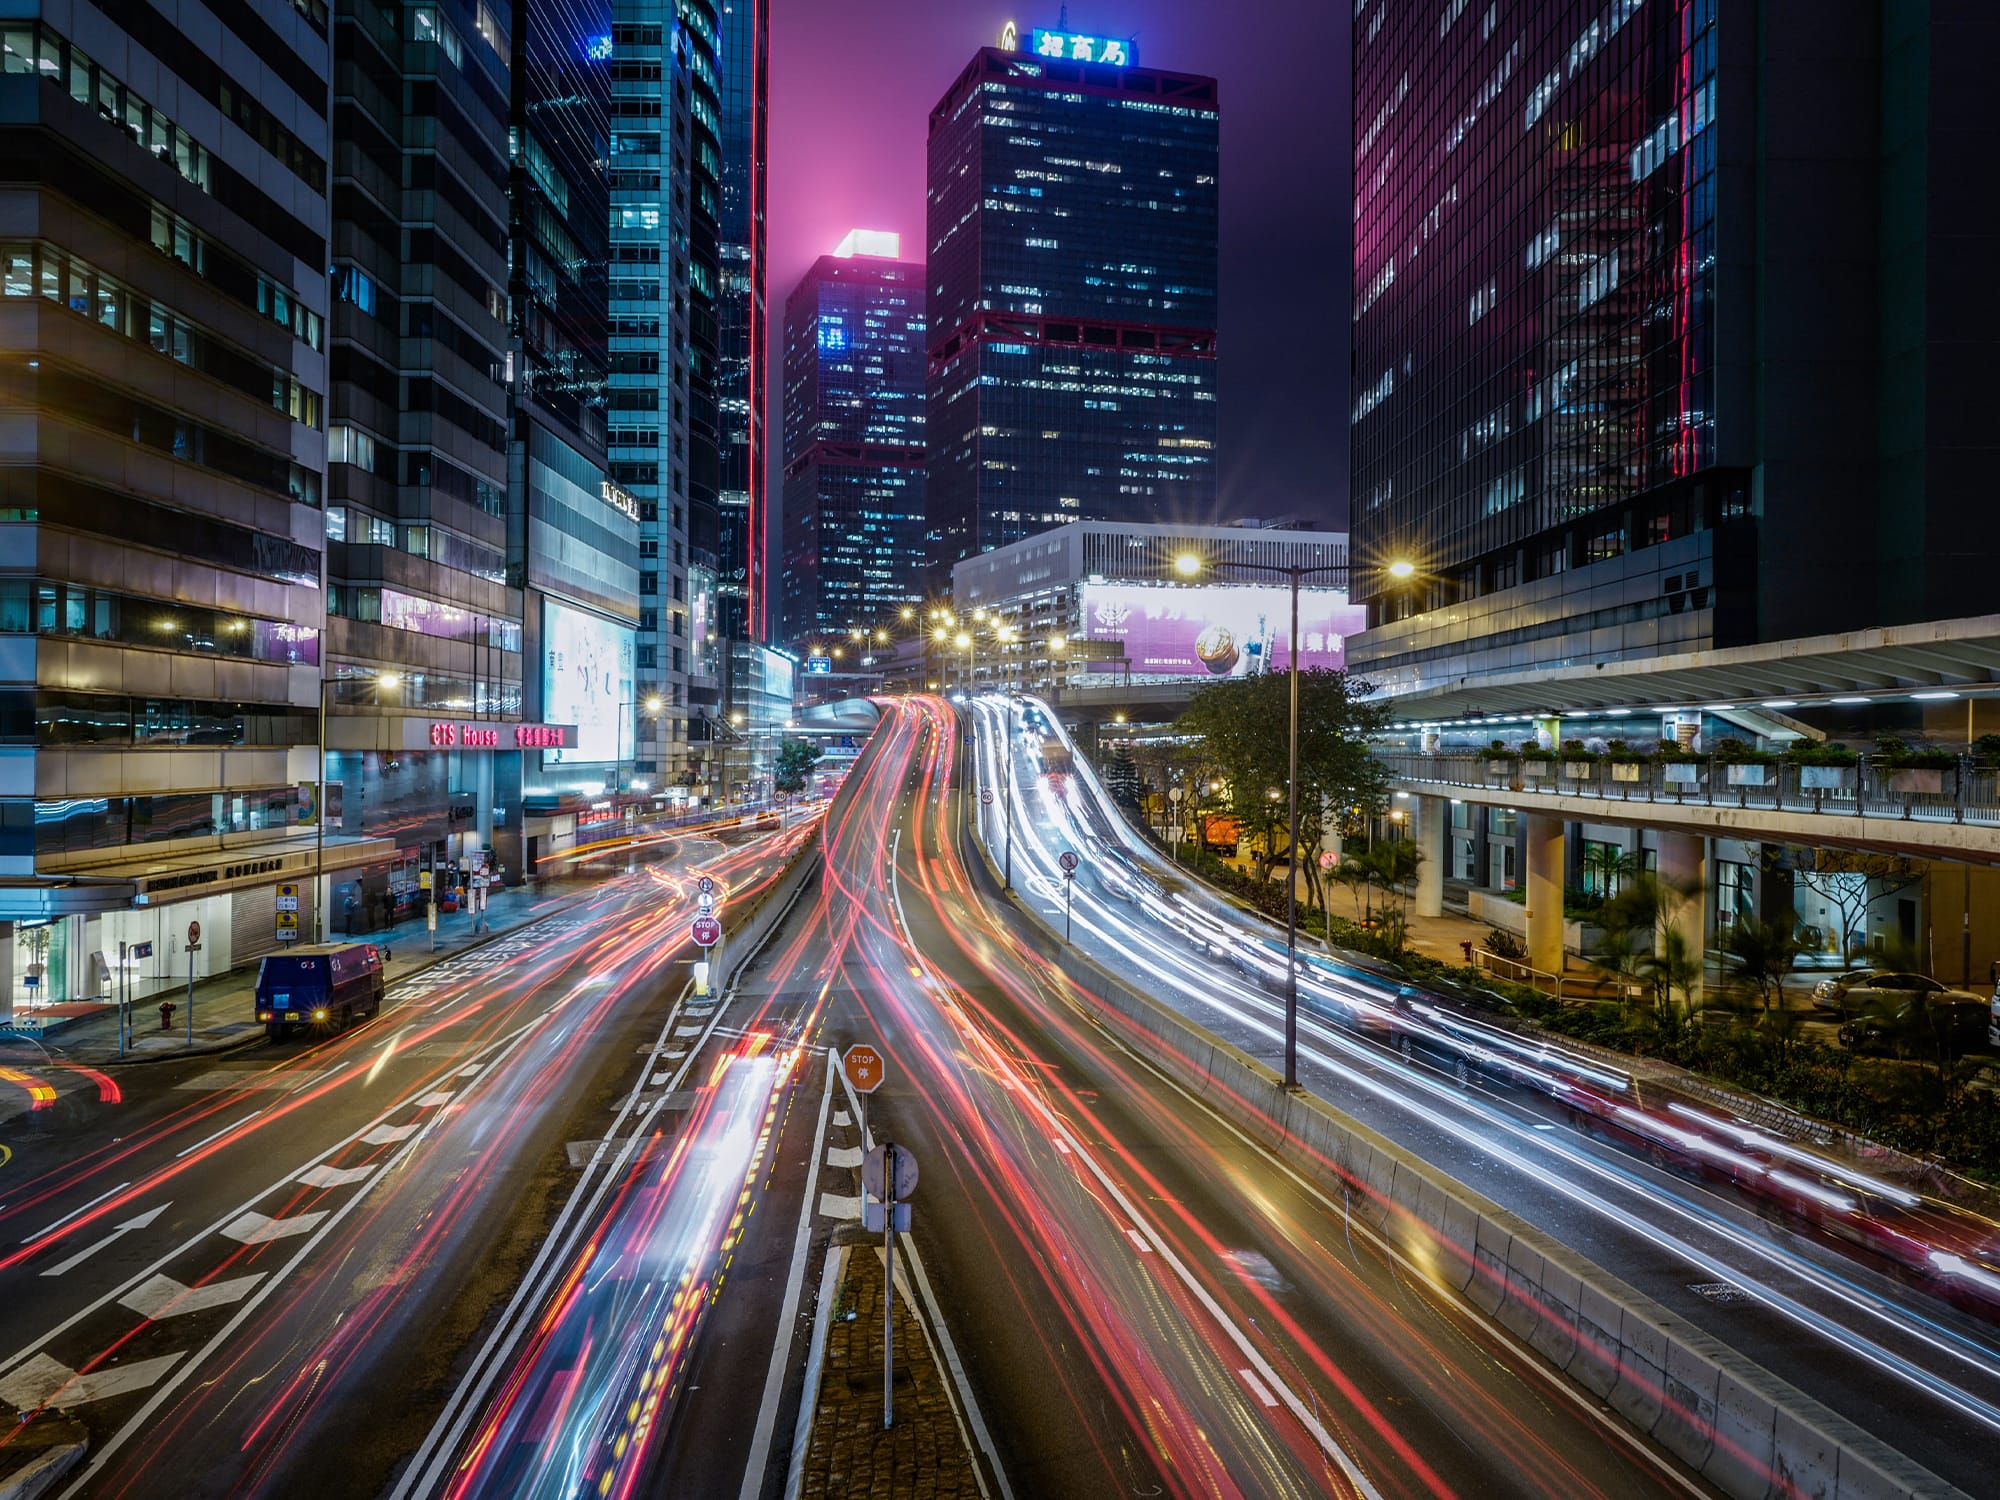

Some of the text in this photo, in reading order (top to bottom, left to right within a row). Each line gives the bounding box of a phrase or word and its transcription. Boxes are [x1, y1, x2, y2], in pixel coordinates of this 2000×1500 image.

[1039, 32, 1125, 66] 招商局
[432, 723, 497, 745] CTS House
[696, 921, 715, 929] STOP
[461, 952, 518, 960] BUS
[434, 961, 506, 970] STOP
[406, 970, 473, 984] 巴士
[851, 1055, 875, 1064] STOP
